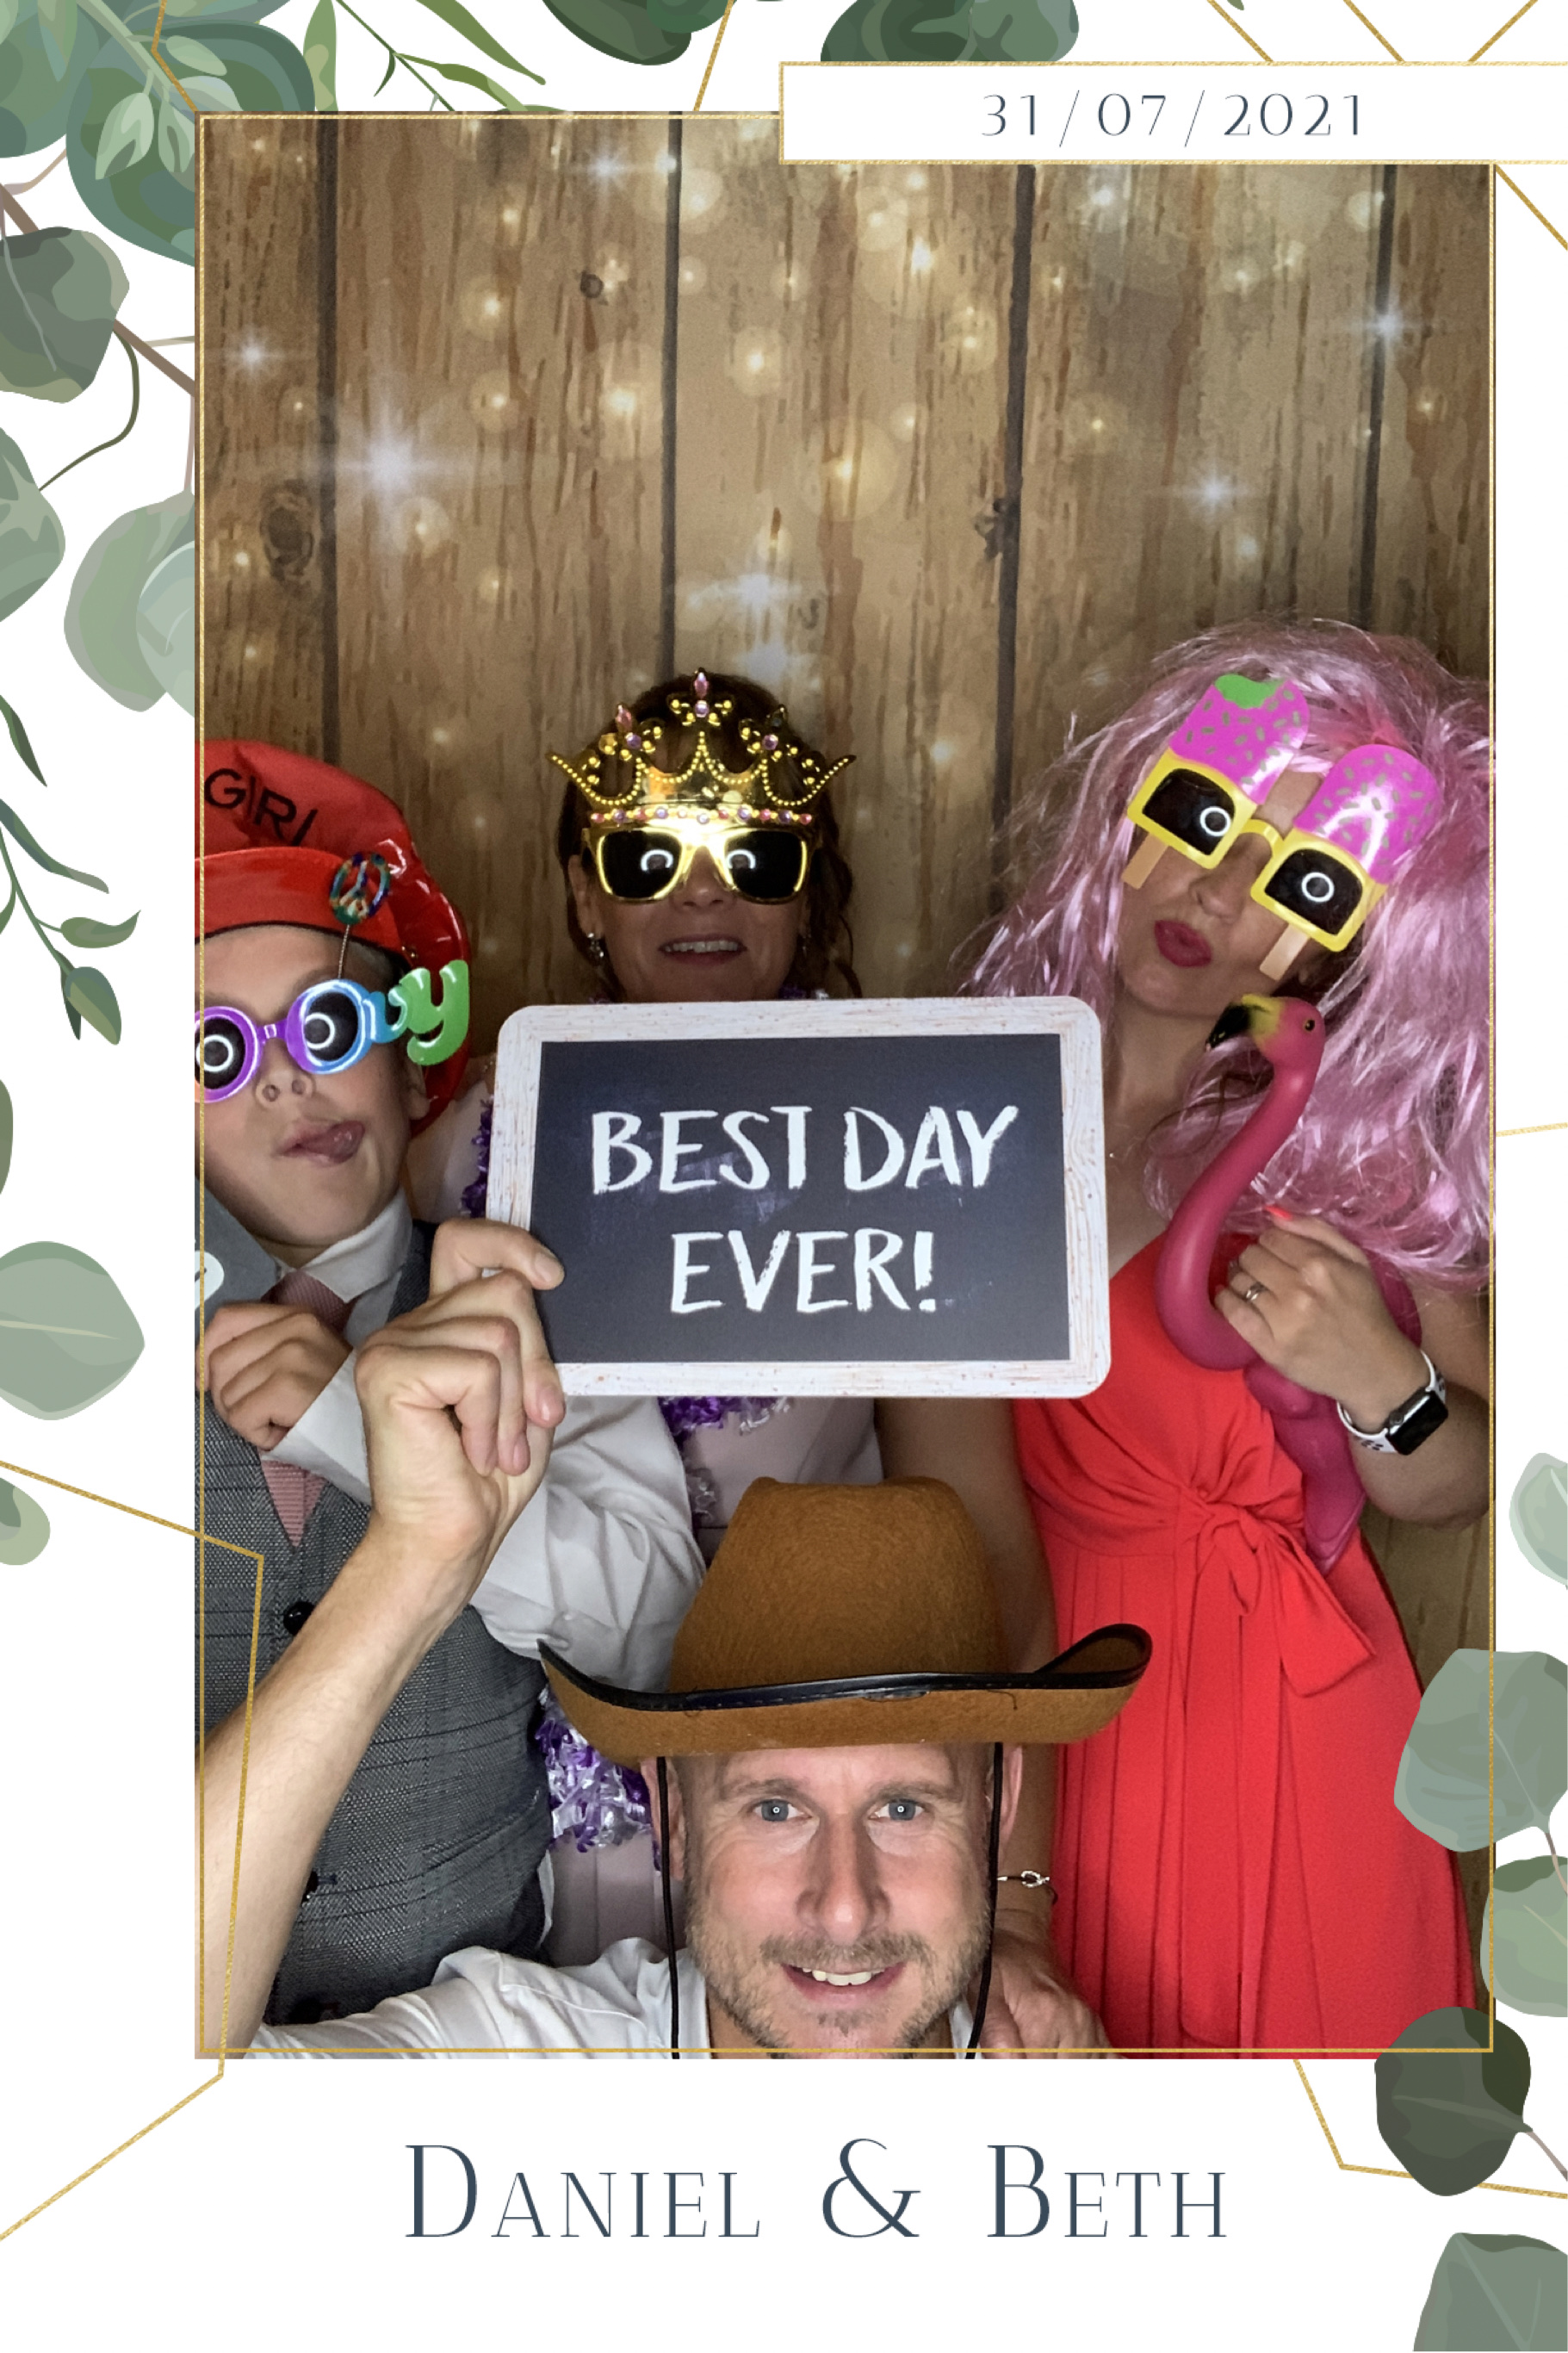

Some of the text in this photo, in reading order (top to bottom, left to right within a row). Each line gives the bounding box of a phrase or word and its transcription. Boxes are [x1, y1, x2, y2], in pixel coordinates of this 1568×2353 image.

[592, 1104, 1020, 1195] BEST DAY
[670, 1227, 937, 1314] EVER!
